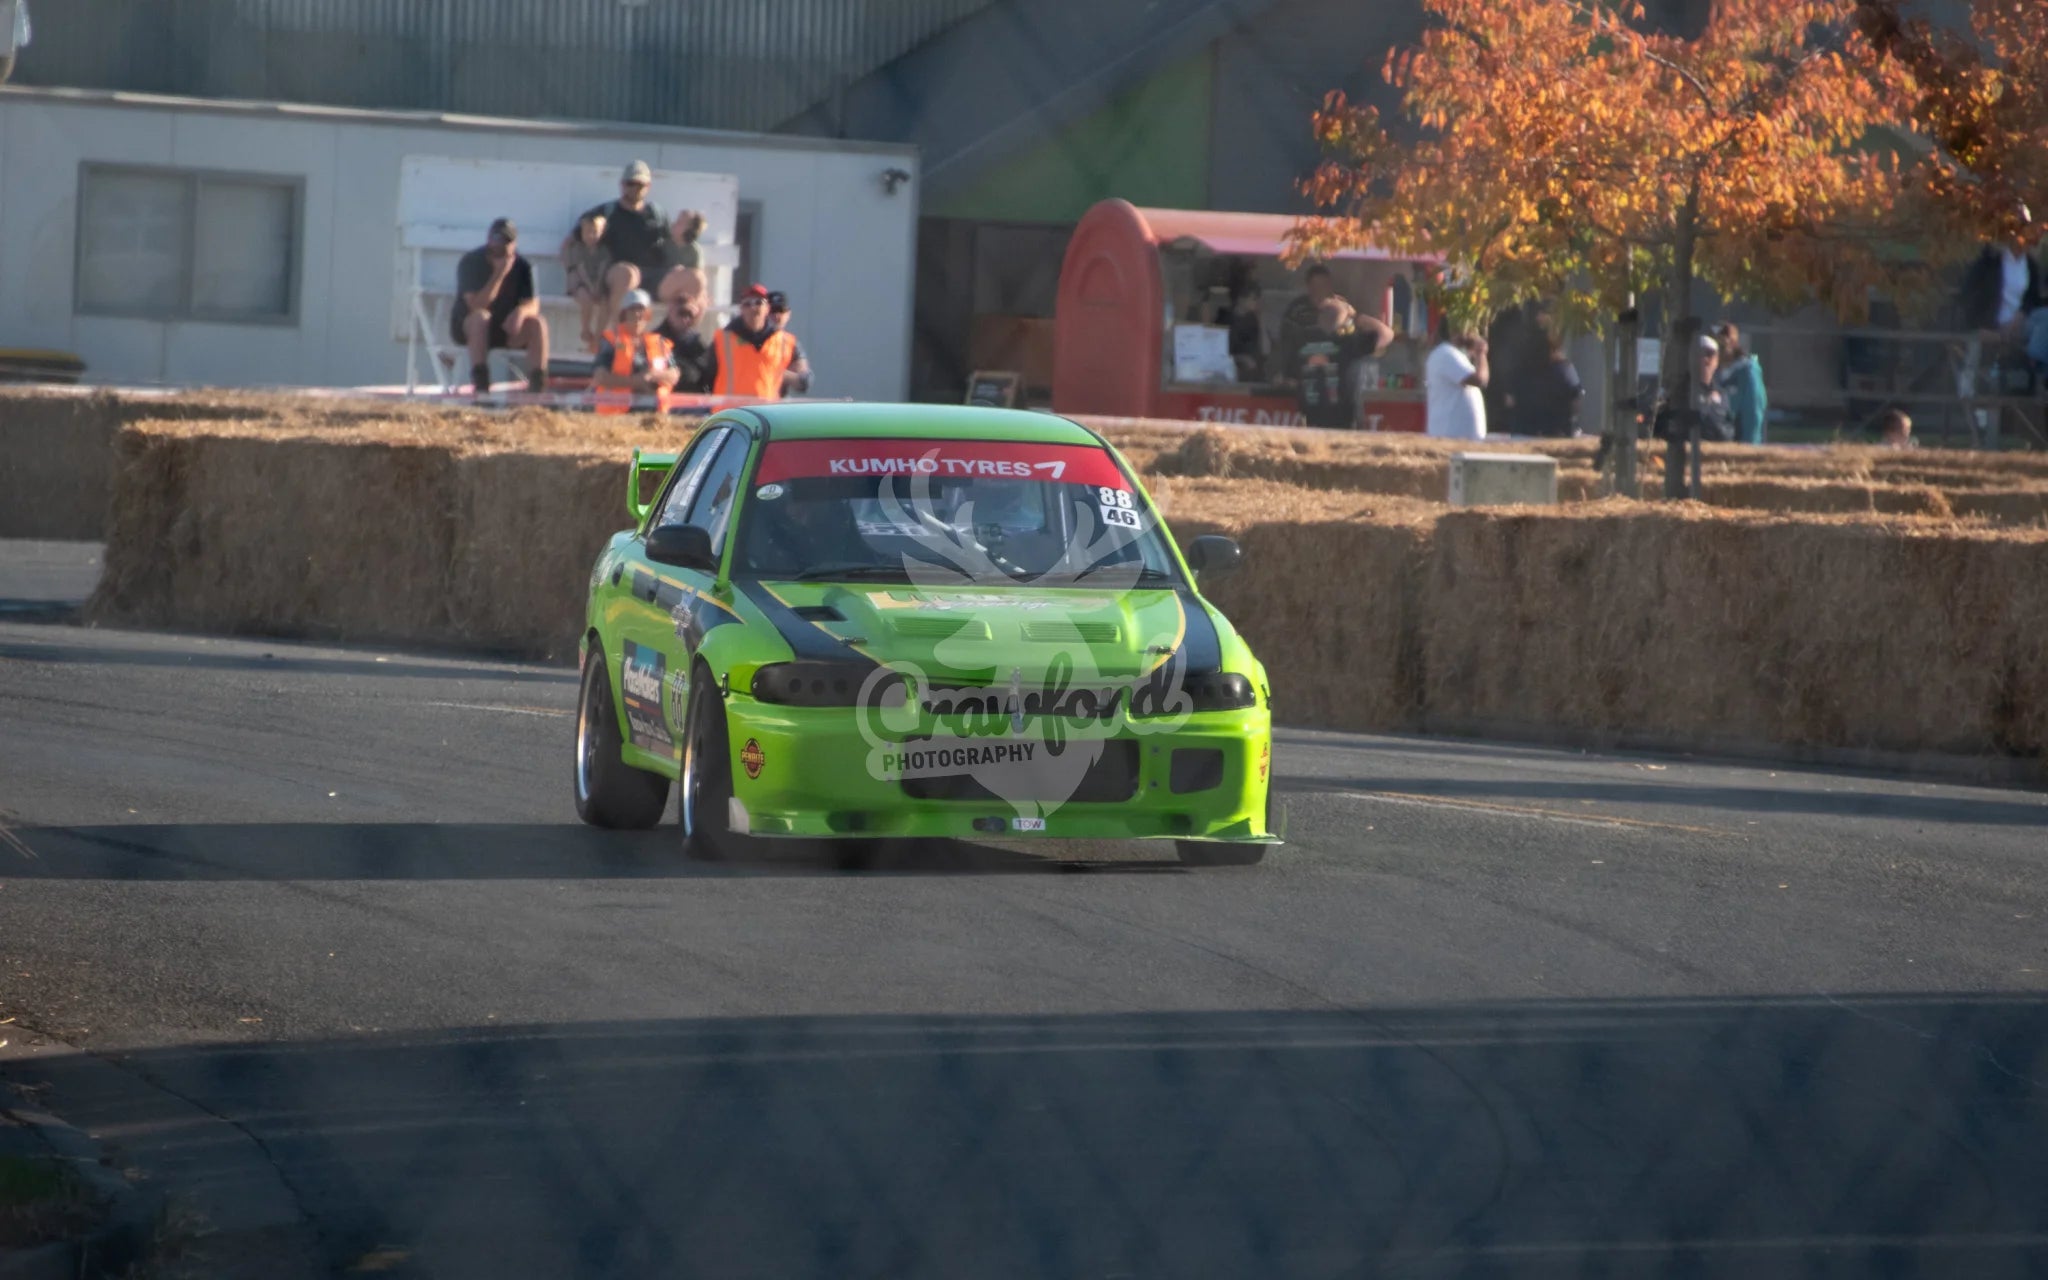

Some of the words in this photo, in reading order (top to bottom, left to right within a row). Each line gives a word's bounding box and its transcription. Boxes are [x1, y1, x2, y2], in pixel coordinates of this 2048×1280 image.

[829, 457, 939, 474] KUMHO
[941, 458, 1032, 477] TYRES
[1099, 486, 1133, 509] 88
[1107, 508, 1137, 526] 46
[1016, 819, 1042, 829] TOW
